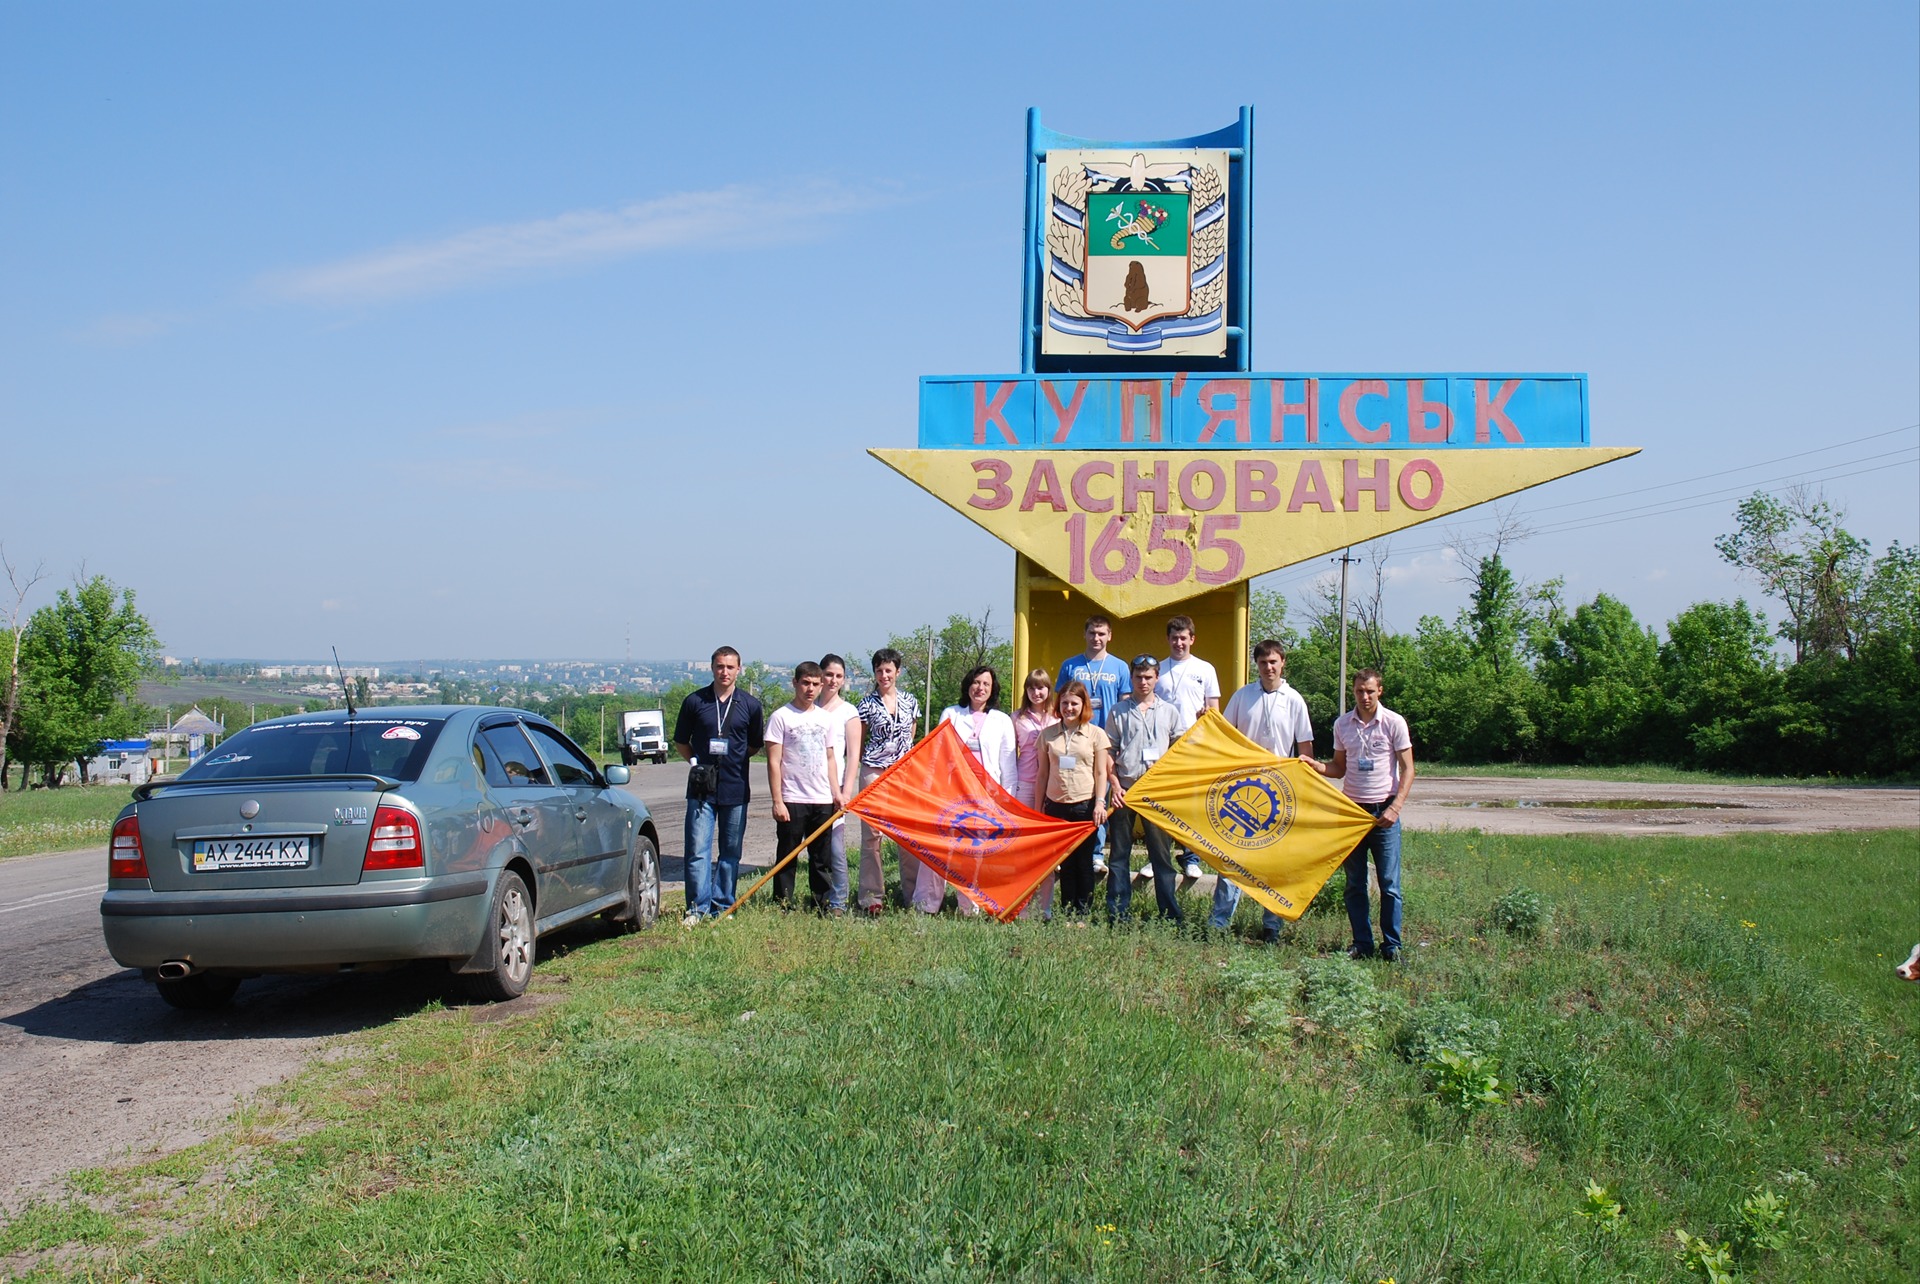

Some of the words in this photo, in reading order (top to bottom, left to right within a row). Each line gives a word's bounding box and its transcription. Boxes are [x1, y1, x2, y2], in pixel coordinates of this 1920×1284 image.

[973, 371, 1524, 445] КУП'ЯНСЬК
[967, 458, 1444, 513] ЗАСНОВАНО
[1064, 513, 1245, 585] 1655
[334, 806, 367, 819] OCTAVIA
[205, 843, 229, 862] AX
[234, 841, 274, 861] 2444
[279, 840, 304, 859] KX
[219, 860, 307, 869] www.skoda-club.org.ua
[1142, 796, 1192, 833] ФАКУЛЬТЕТ
[1191, 827, 1260, 884] ТРАНСПОРТНИХ
[1256, 880, 1294, 910] СИСТЕМ
[967, 881, 1005, 914] ФАКУЛЬТ
